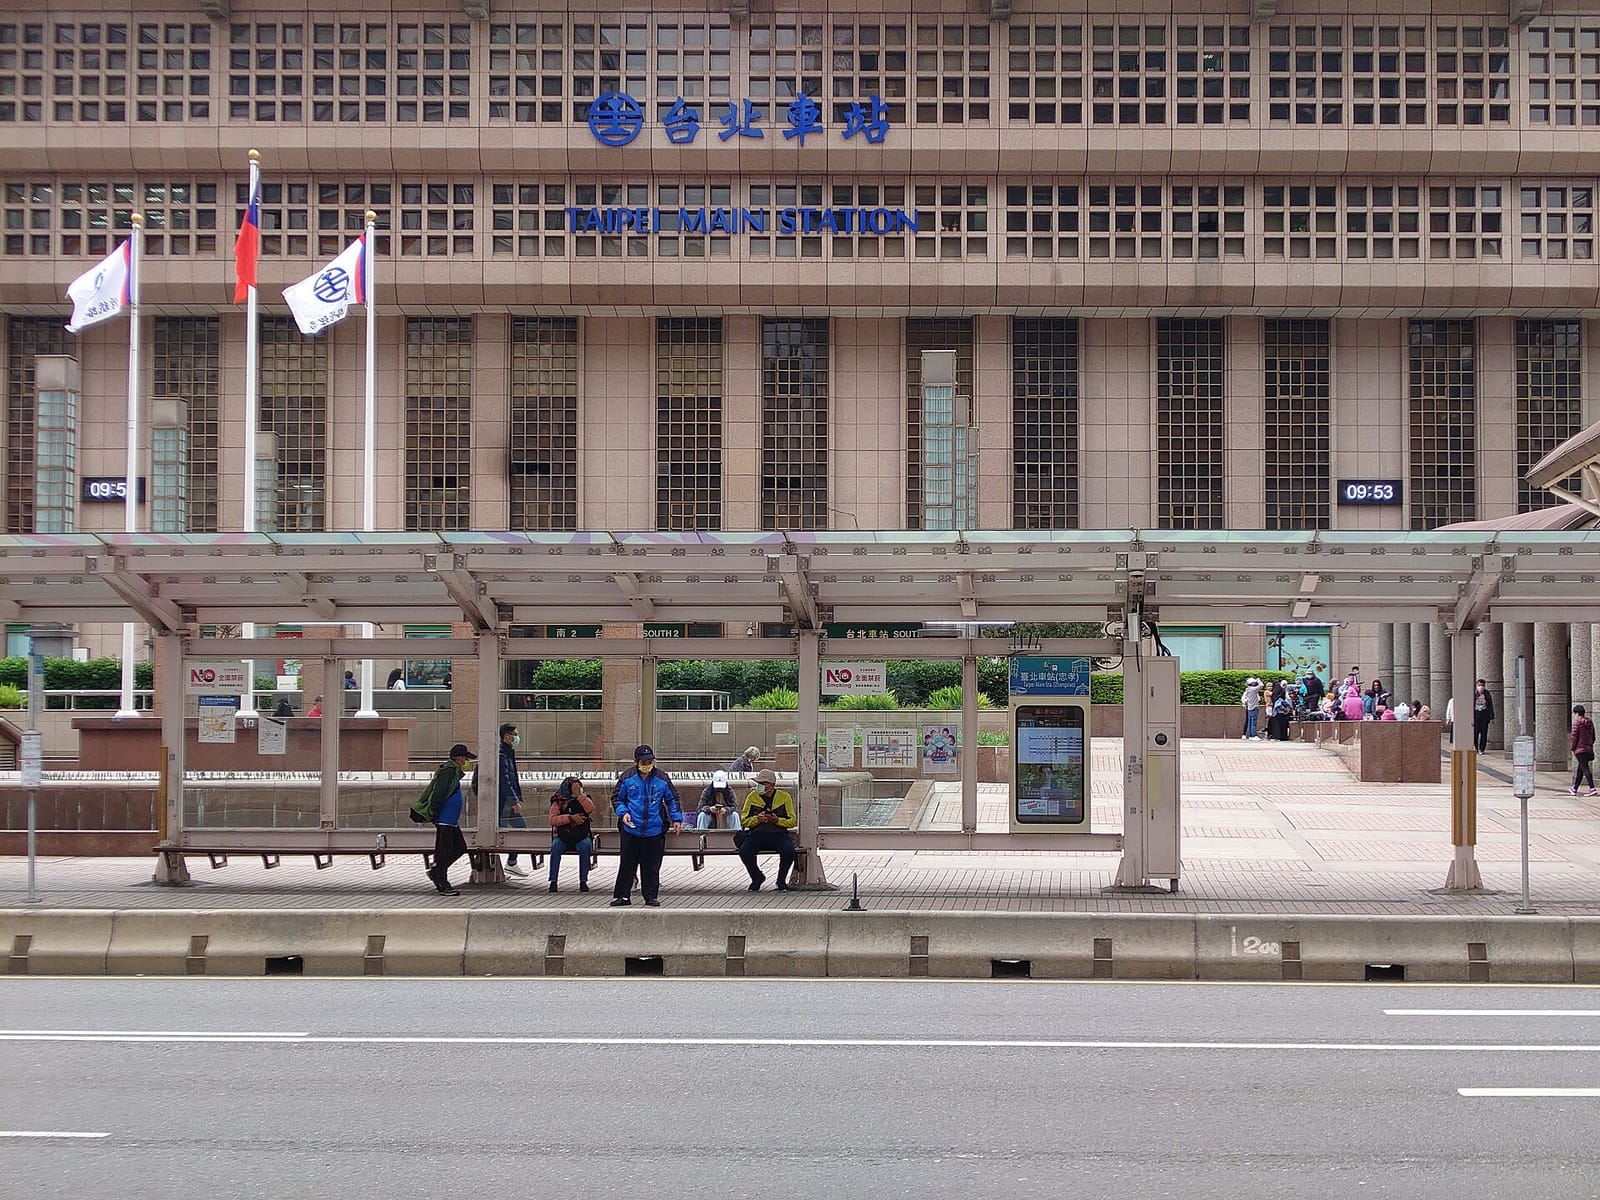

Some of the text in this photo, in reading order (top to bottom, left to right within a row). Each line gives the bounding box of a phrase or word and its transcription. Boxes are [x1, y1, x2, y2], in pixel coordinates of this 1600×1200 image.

[663, 92, 890, 147] 台北車站
[564, 207, 920, 235] TAIPEI MAIN STATION
[90, 482, 128, 497] 09:5
[1347, 484, 1393, 499] 09:53
[556, 628, 577, 638] 南 2
[846, 629, 920, 639] 台北車站 SOUT
[190, 668, 216, 683] NO
[826, 669, 853, 683] NO
